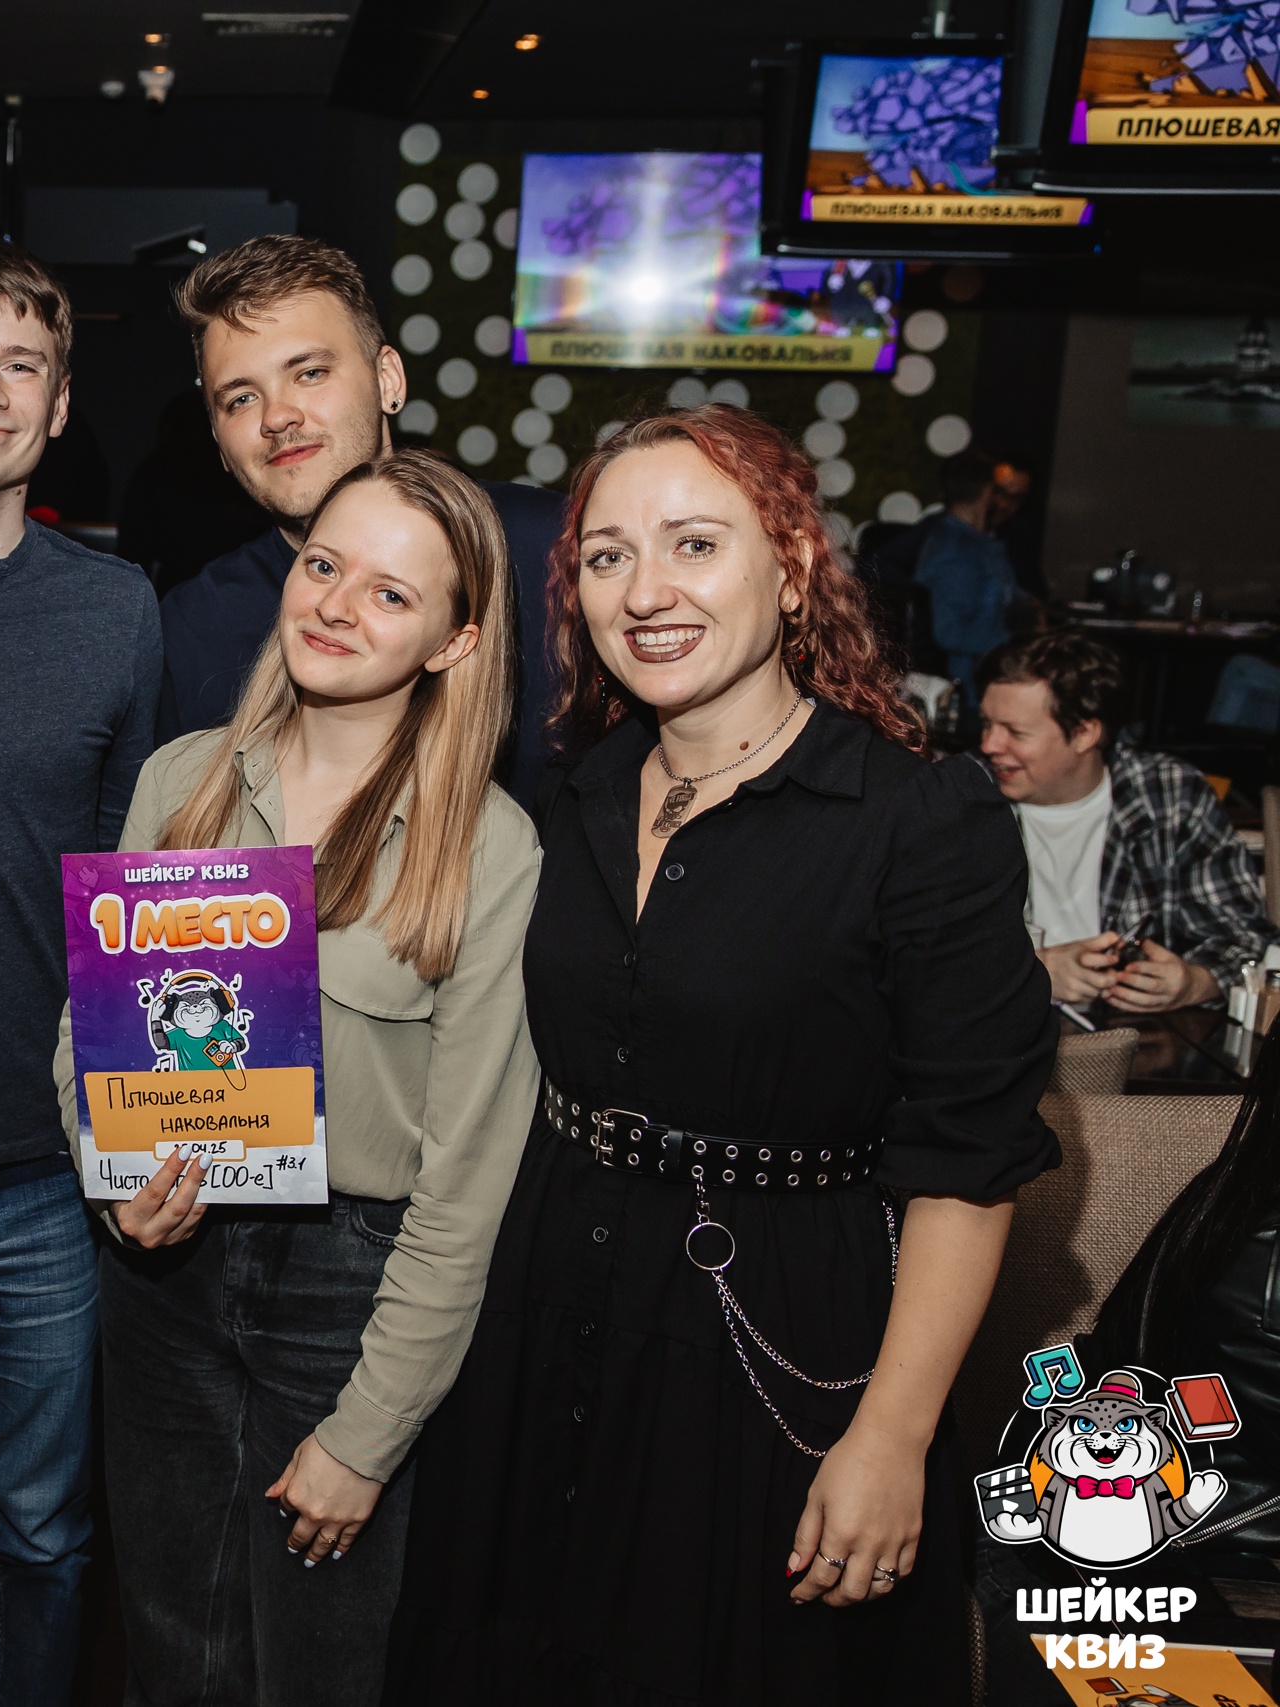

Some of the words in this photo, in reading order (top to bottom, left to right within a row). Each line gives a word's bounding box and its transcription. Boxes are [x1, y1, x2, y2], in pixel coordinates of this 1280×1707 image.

[1117, 117, 1280, 137] ПЛЮШЕВАЯ
[124, 863, 195, 882] ШЕЙКЕР
[200, 864, 249, 880] КВИЗ
[93, 897, 122, 950] 1
[133, 896, 287, 950] МЕСТО
